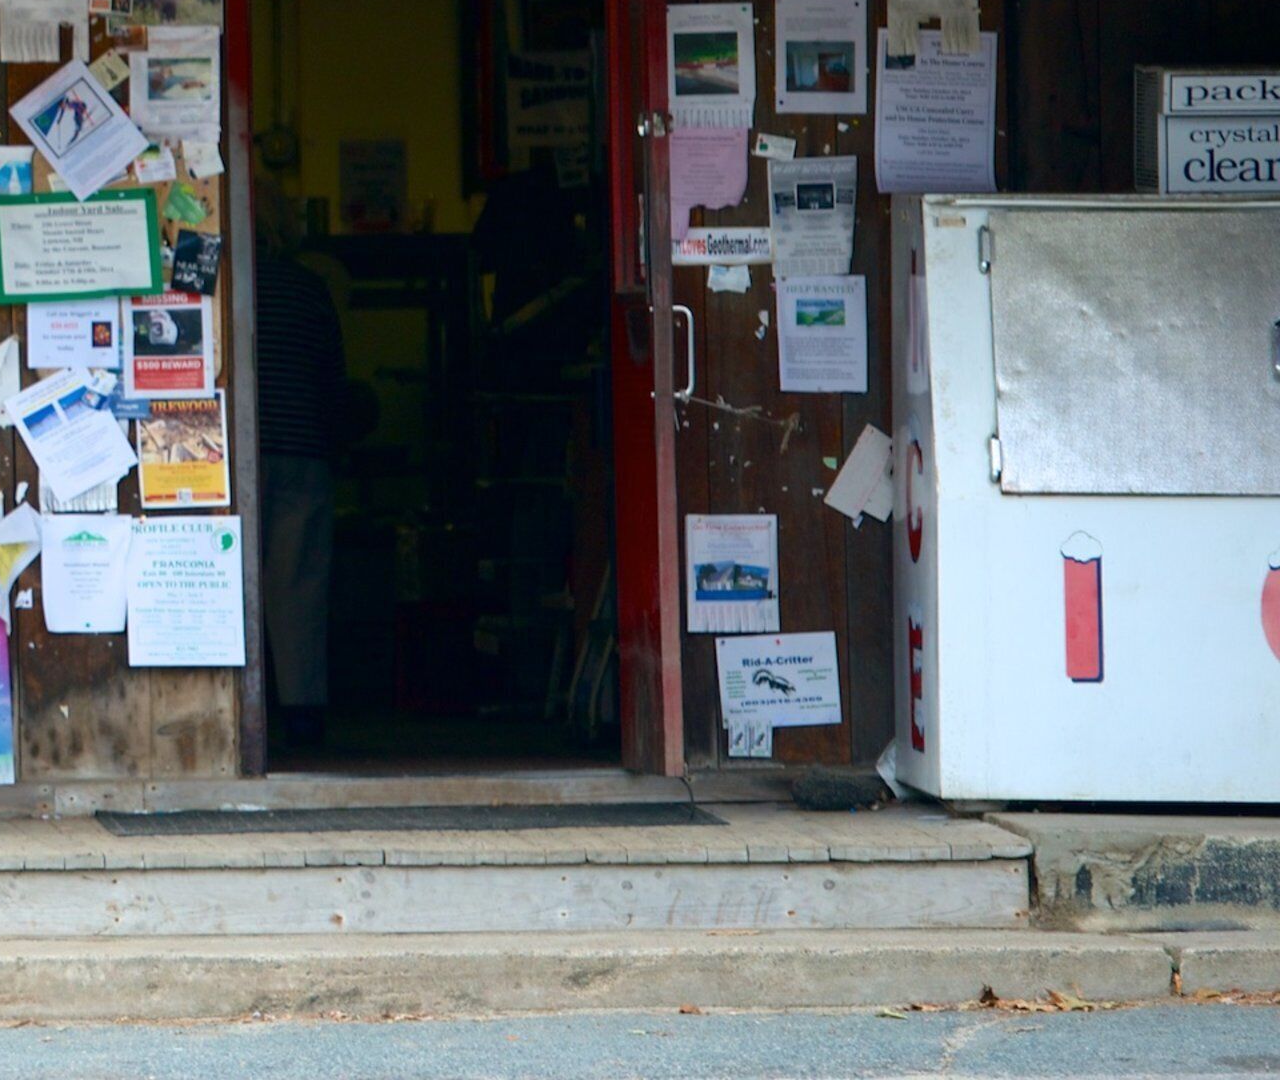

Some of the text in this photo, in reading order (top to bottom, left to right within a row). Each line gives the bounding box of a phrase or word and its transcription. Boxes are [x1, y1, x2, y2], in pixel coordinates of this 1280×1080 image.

[1190, 125, 1280, 148] crystal
[1183, 148, 1280, 183] clear
[741, 655, 814, 669] Rid-A-Critter
